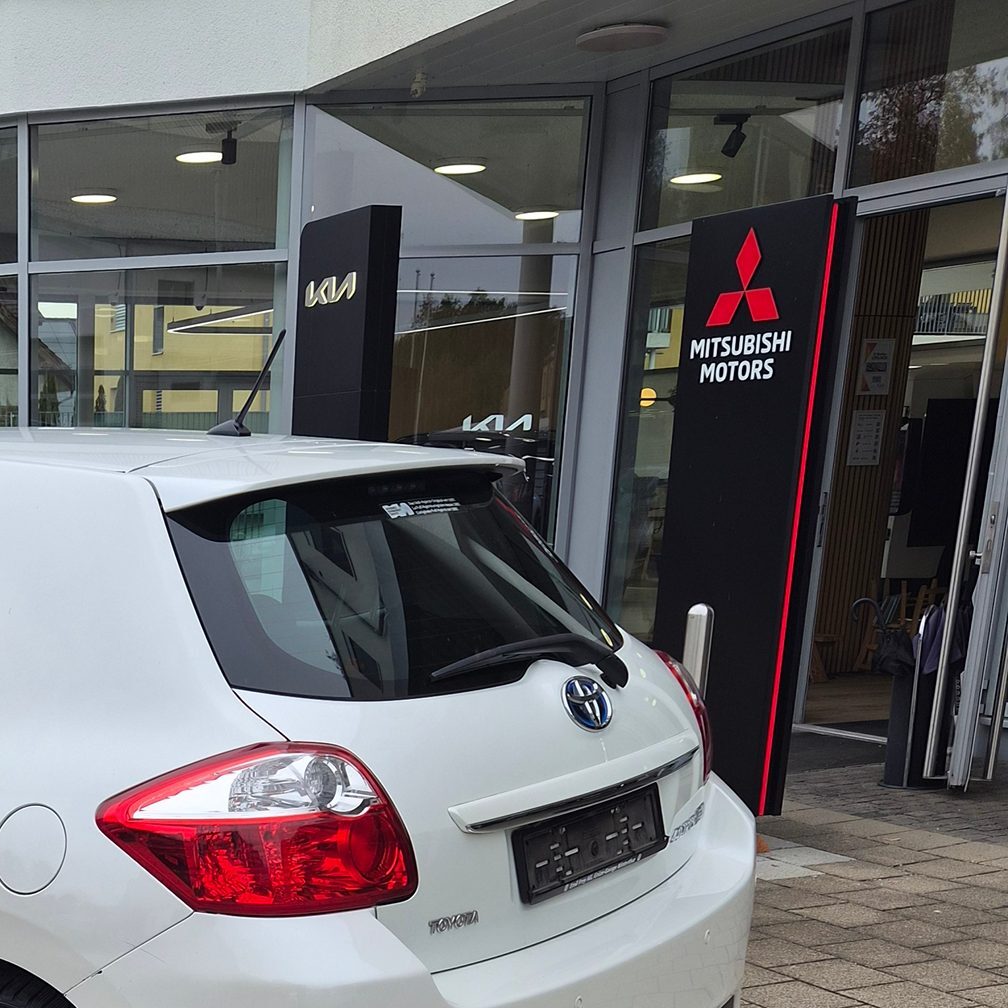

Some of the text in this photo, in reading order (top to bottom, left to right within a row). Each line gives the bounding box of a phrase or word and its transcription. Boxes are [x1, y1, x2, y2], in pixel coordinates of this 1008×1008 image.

[689, 330, 792, 360] MITSUBISHI
[699, 358, 775, 384] MOTORS
[428, 909, 479, 935] TOYOTA
